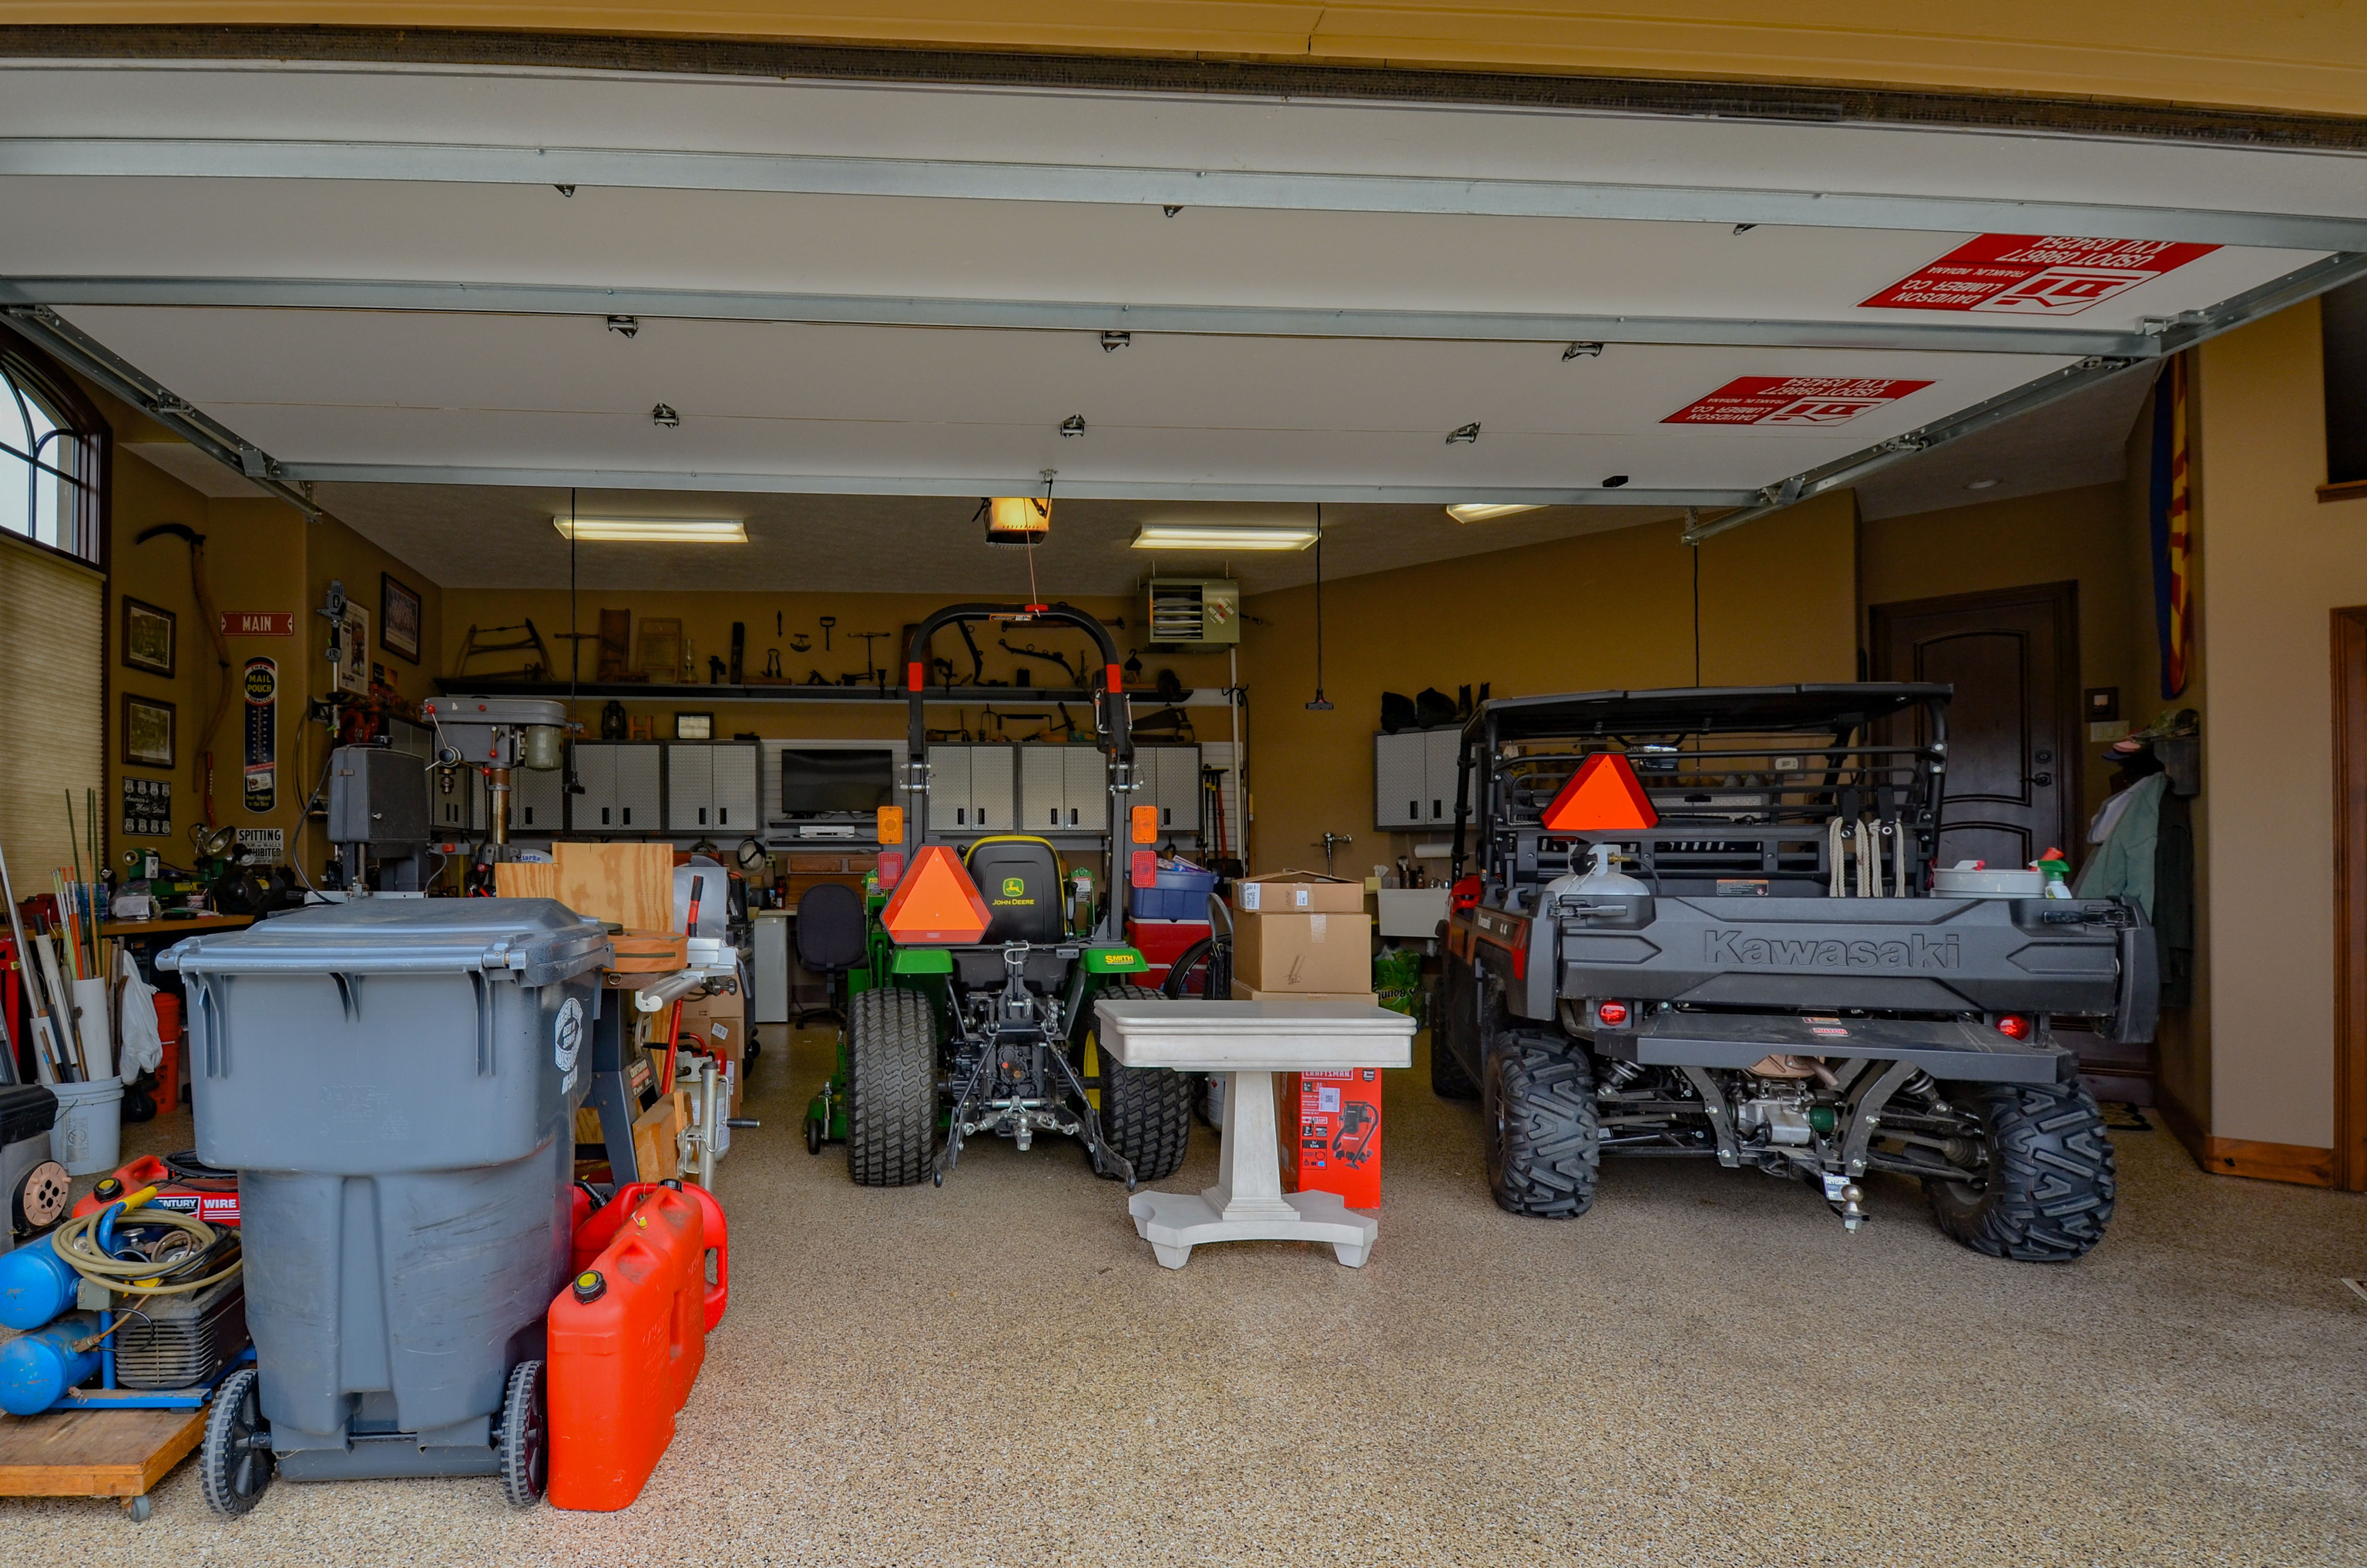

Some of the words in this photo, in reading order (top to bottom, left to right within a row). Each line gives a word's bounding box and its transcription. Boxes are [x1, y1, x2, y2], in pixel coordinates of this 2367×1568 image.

[2114, 239, 2175, 254] KYU
[1994, 249, 2082, 264] 098677
[2070, 252, 2155, 267] USDOT
[1927, 266, 1973, 275] INDIANA
[1932, 281, 2005, 293] LUMBER
[1890, 291, 1983, 304] DAVIDSON
[1849, 380, 1896, 388] KYU
[1757, 386, 1824, 396] 098677
[1818, 388, 1885, 397] USDOT
[242, 617, 272, 632] MAIN
[249, 674, 271, 683] MAIL
[247, 683, 272, 693] POUCH
[239, 830, 281, 841] SPITTING
[1704, 930, 1960, 969] Kawasaki
[1105, 955, 1135, 964] SMITH
[1305, 1069, 1351, 1078] CRAFTSMAN
[157, 1199, 197, 1207] NTURY
[203, 1199, 237, 1208] WIRE
